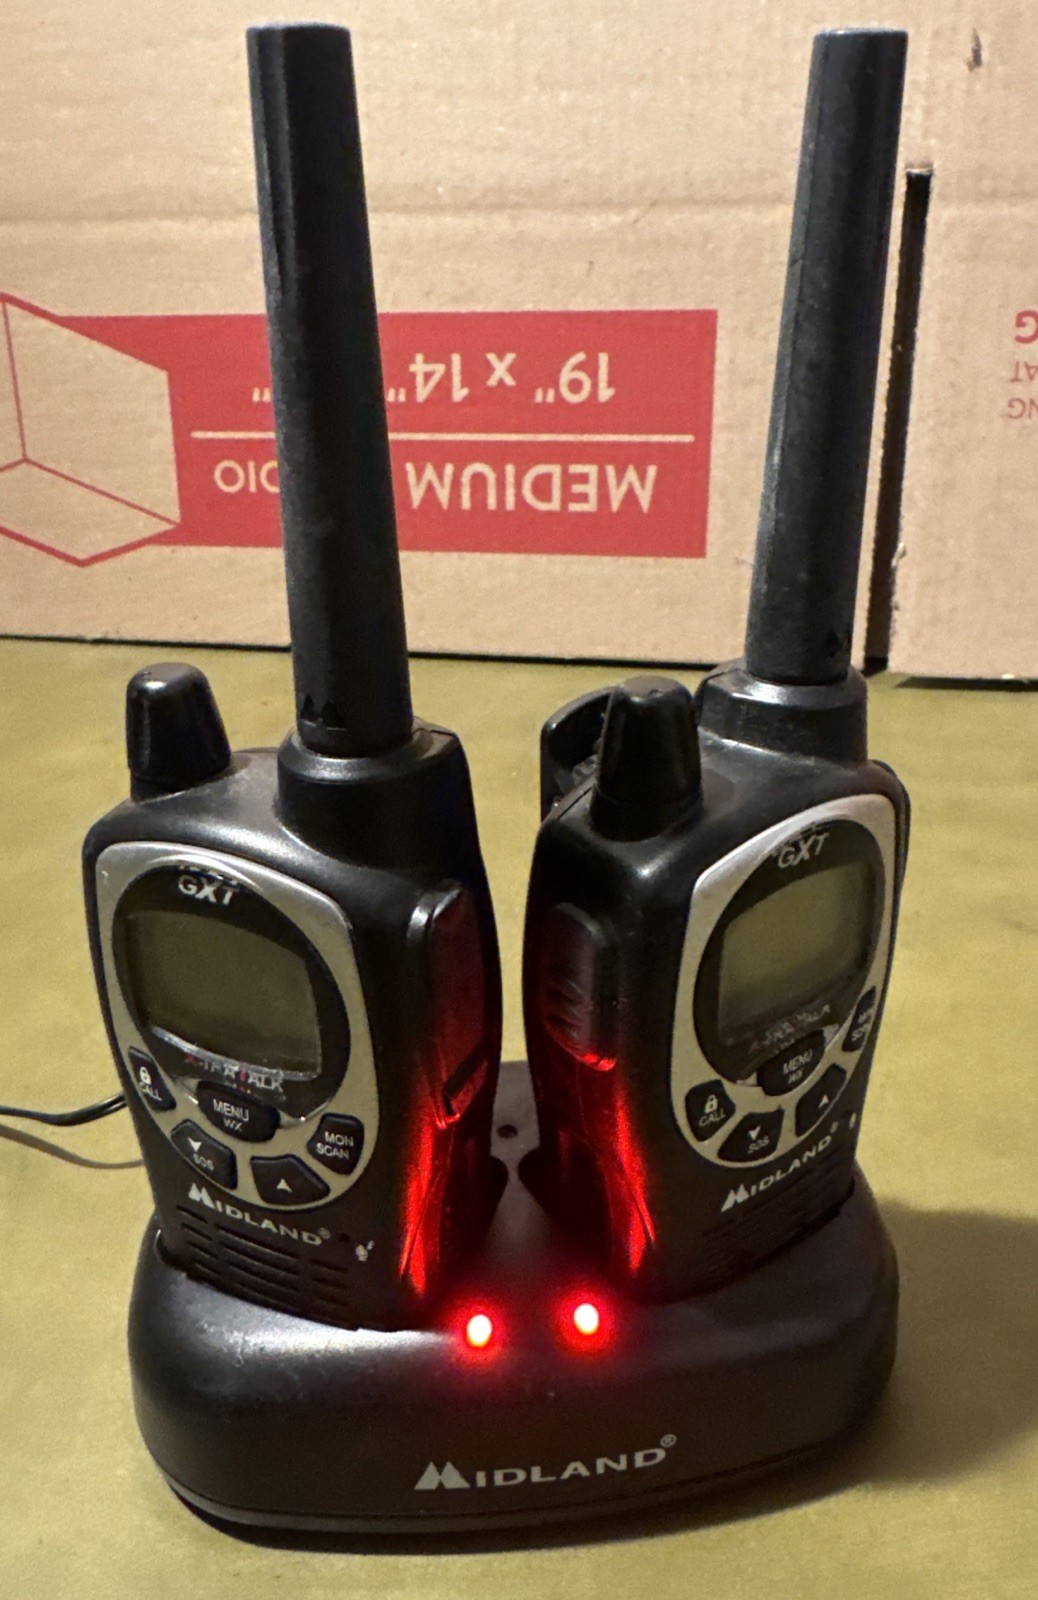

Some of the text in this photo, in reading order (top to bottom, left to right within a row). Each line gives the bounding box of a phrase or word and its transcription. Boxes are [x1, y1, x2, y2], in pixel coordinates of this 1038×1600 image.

[535, 351, 616, 403] 19"
[213, 459, 658, 514] MEDIUM DIO
[778, 831, 830, 869] GXT
[178, 874, 238, 906] GXT
[213, 1098, 250, 1122] MENU
[699, 1111, 727, 1127] CALL
[316, 1142, 351, 1160] SCAN
[324, 1130, 355, 1148] MON
